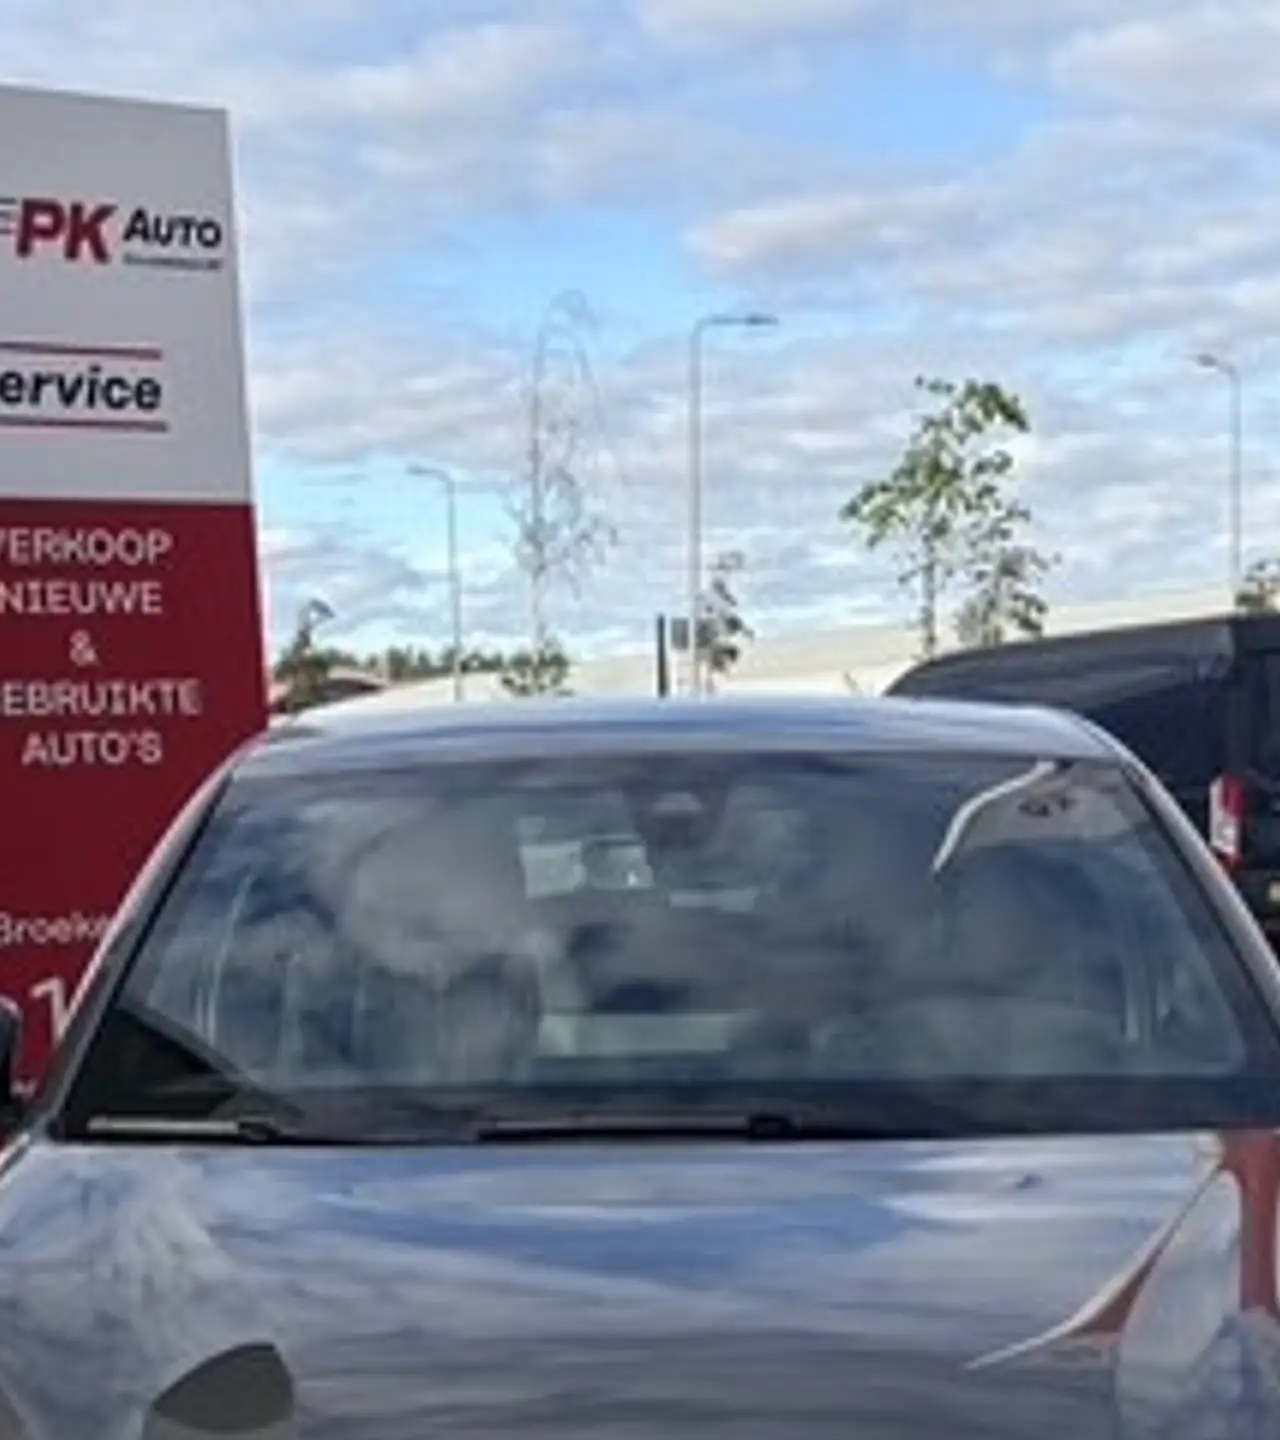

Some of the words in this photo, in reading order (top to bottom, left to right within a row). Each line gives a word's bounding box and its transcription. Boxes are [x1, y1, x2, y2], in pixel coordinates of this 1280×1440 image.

[16, 198, 115, 263] PK
[70, 630, 97, 667] &
[20, 730, 163, 766] AUTO'S
